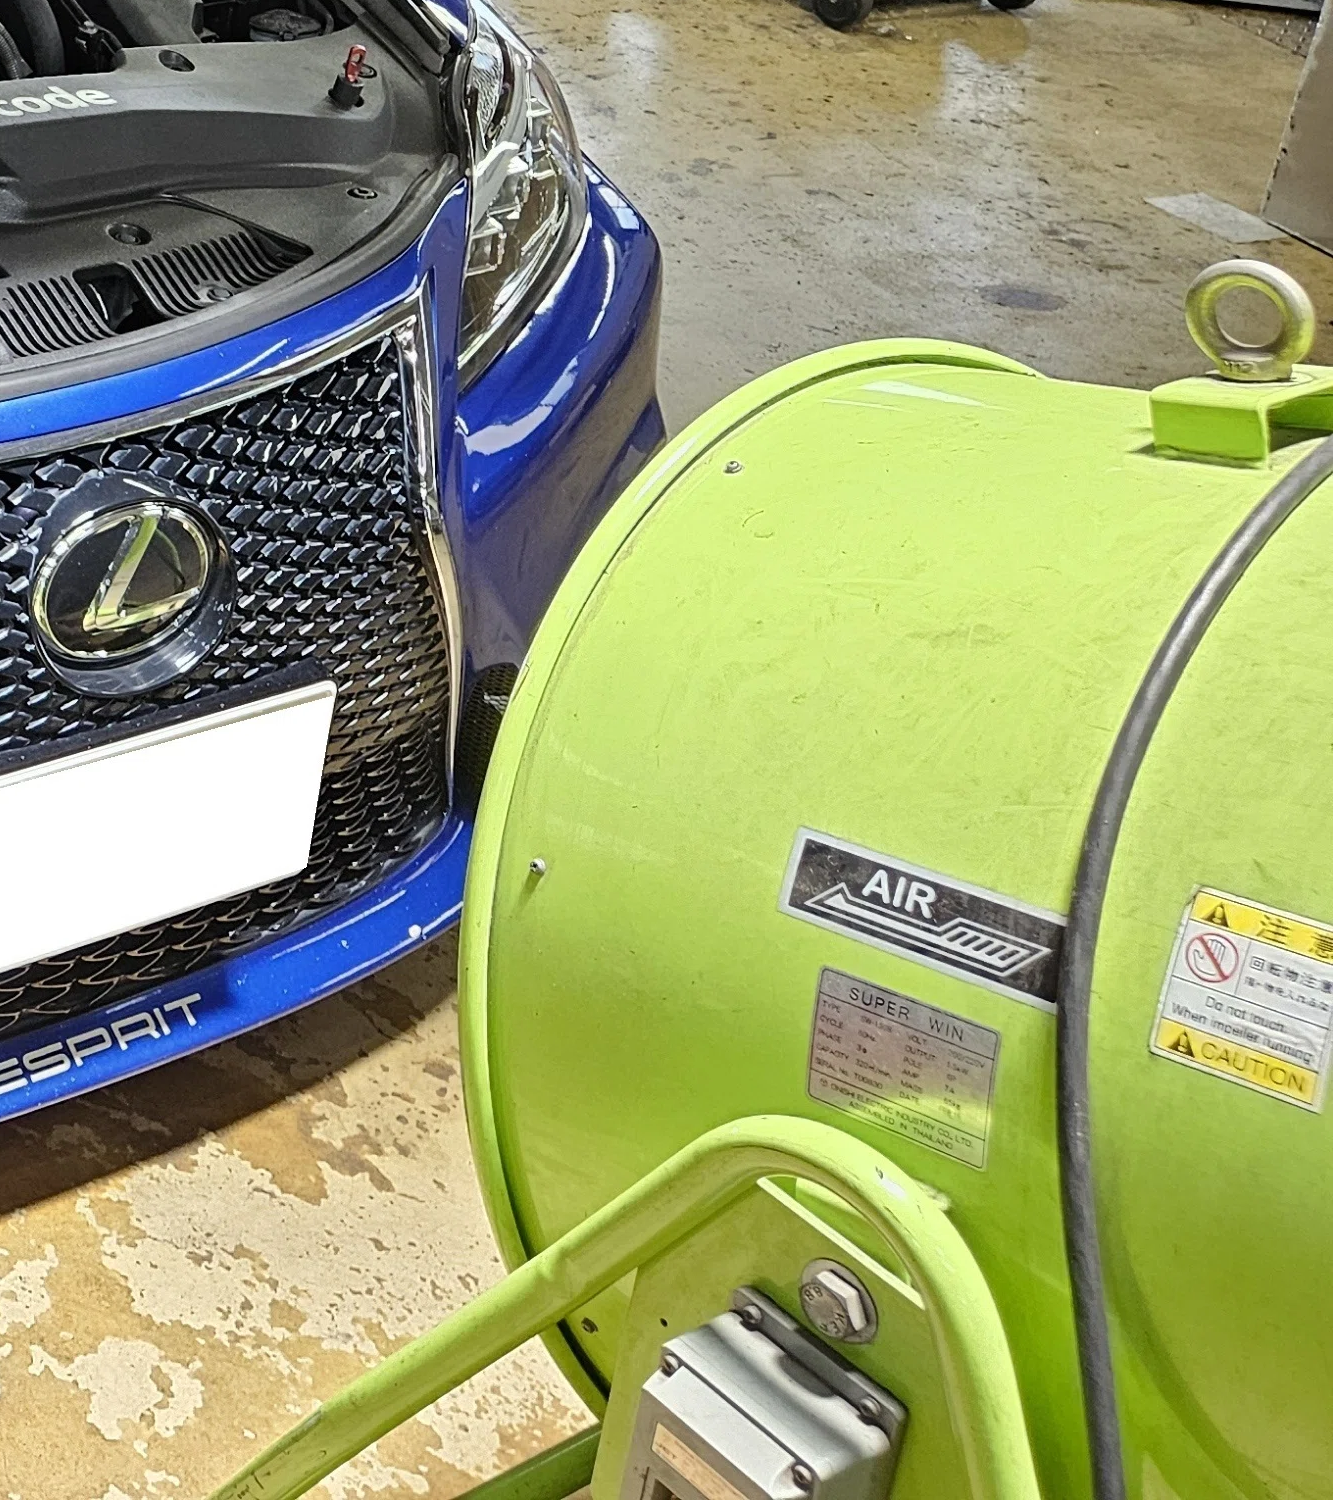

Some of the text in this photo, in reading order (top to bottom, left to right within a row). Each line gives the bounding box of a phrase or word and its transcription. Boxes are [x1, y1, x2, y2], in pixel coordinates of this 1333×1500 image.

[862, 869, 939, 919] AIR
[849, 987, 964, 1042] SUPER WIN
[1172, 1003, 1207, 1024] When
[1205, 996, 1222, 1011] Do
[1226, 1005, 1247, 1020] not
[1201, 1042, 1305, 1093] CAUTION
